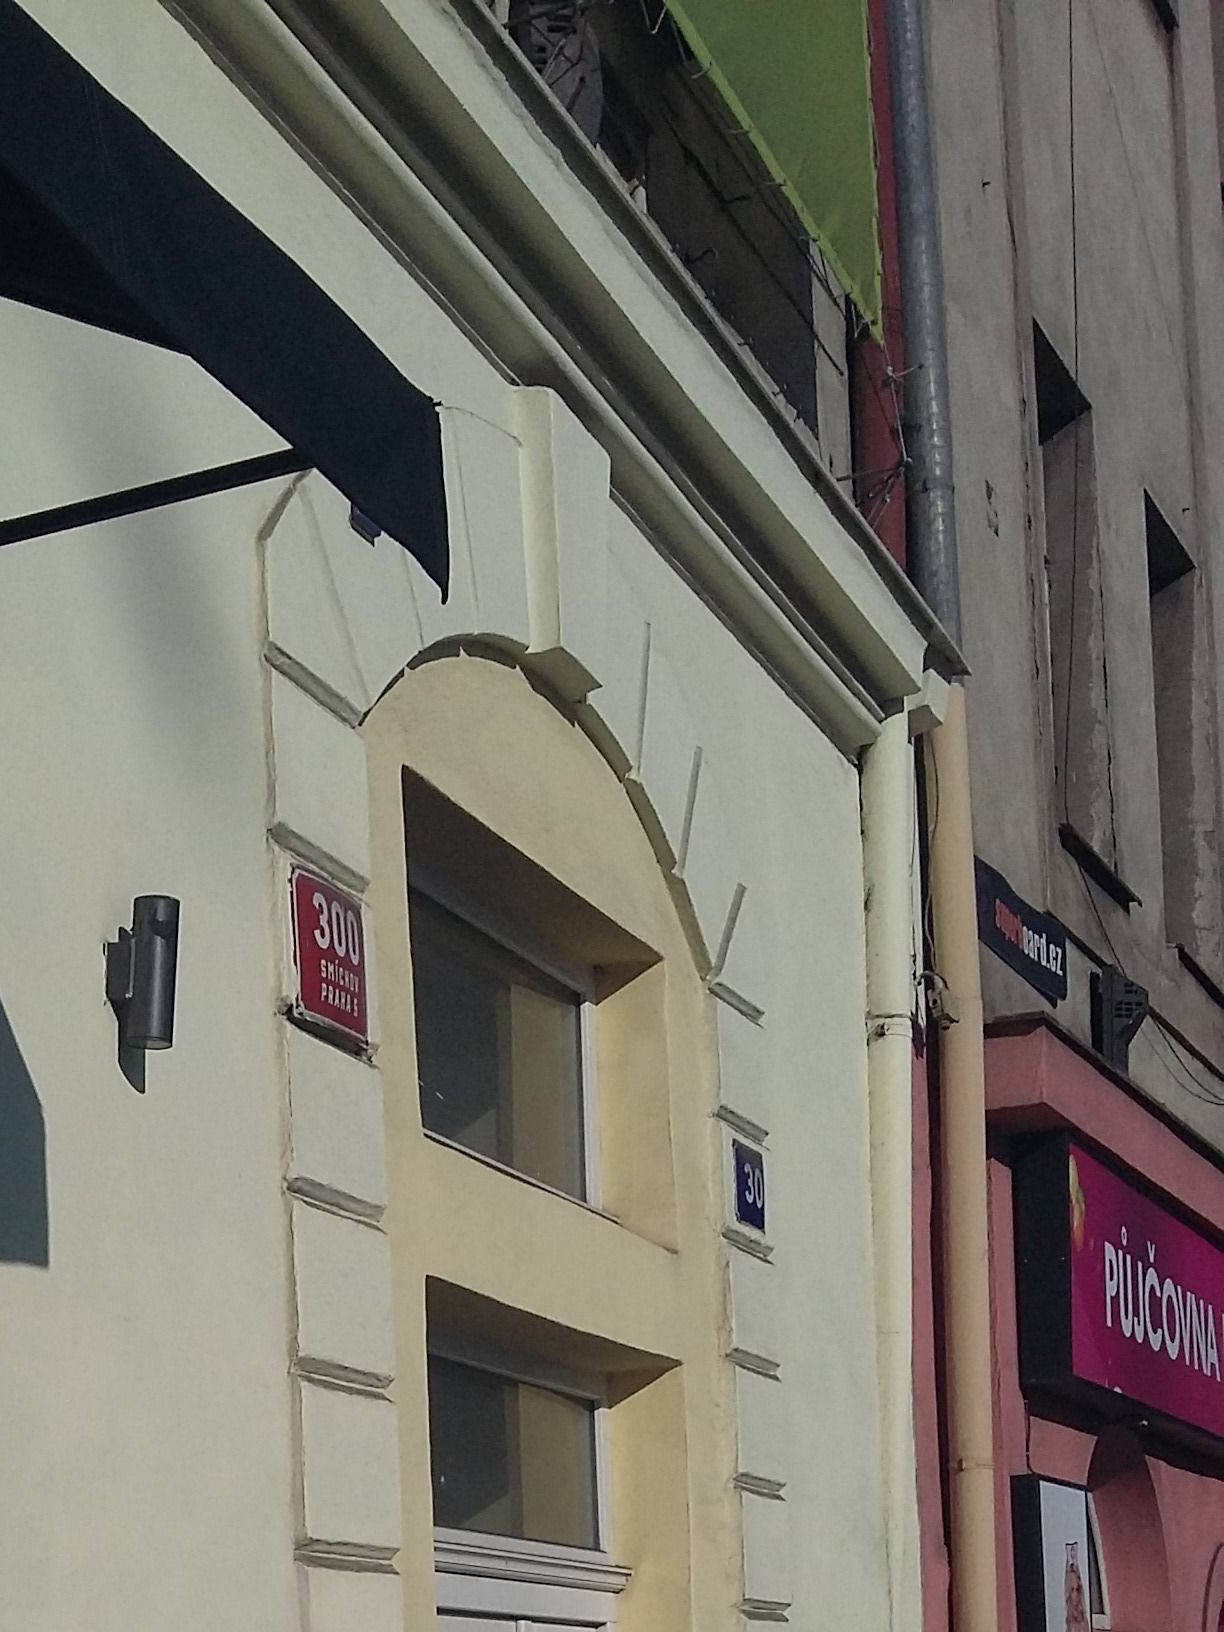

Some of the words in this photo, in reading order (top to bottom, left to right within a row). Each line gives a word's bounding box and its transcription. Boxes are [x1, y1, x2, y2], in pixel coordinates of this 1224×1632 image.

[312, 891, 360, 966] 300
[320, 959, 359, 993] SMÍCHOV
[320, 982, 351, 1014] PRAHA
[353, 997, 358, 1017] 5
[744, 1162, 764, 1209] 30
[1104, 1225, 1221, 1382] PŮJČOVNA
